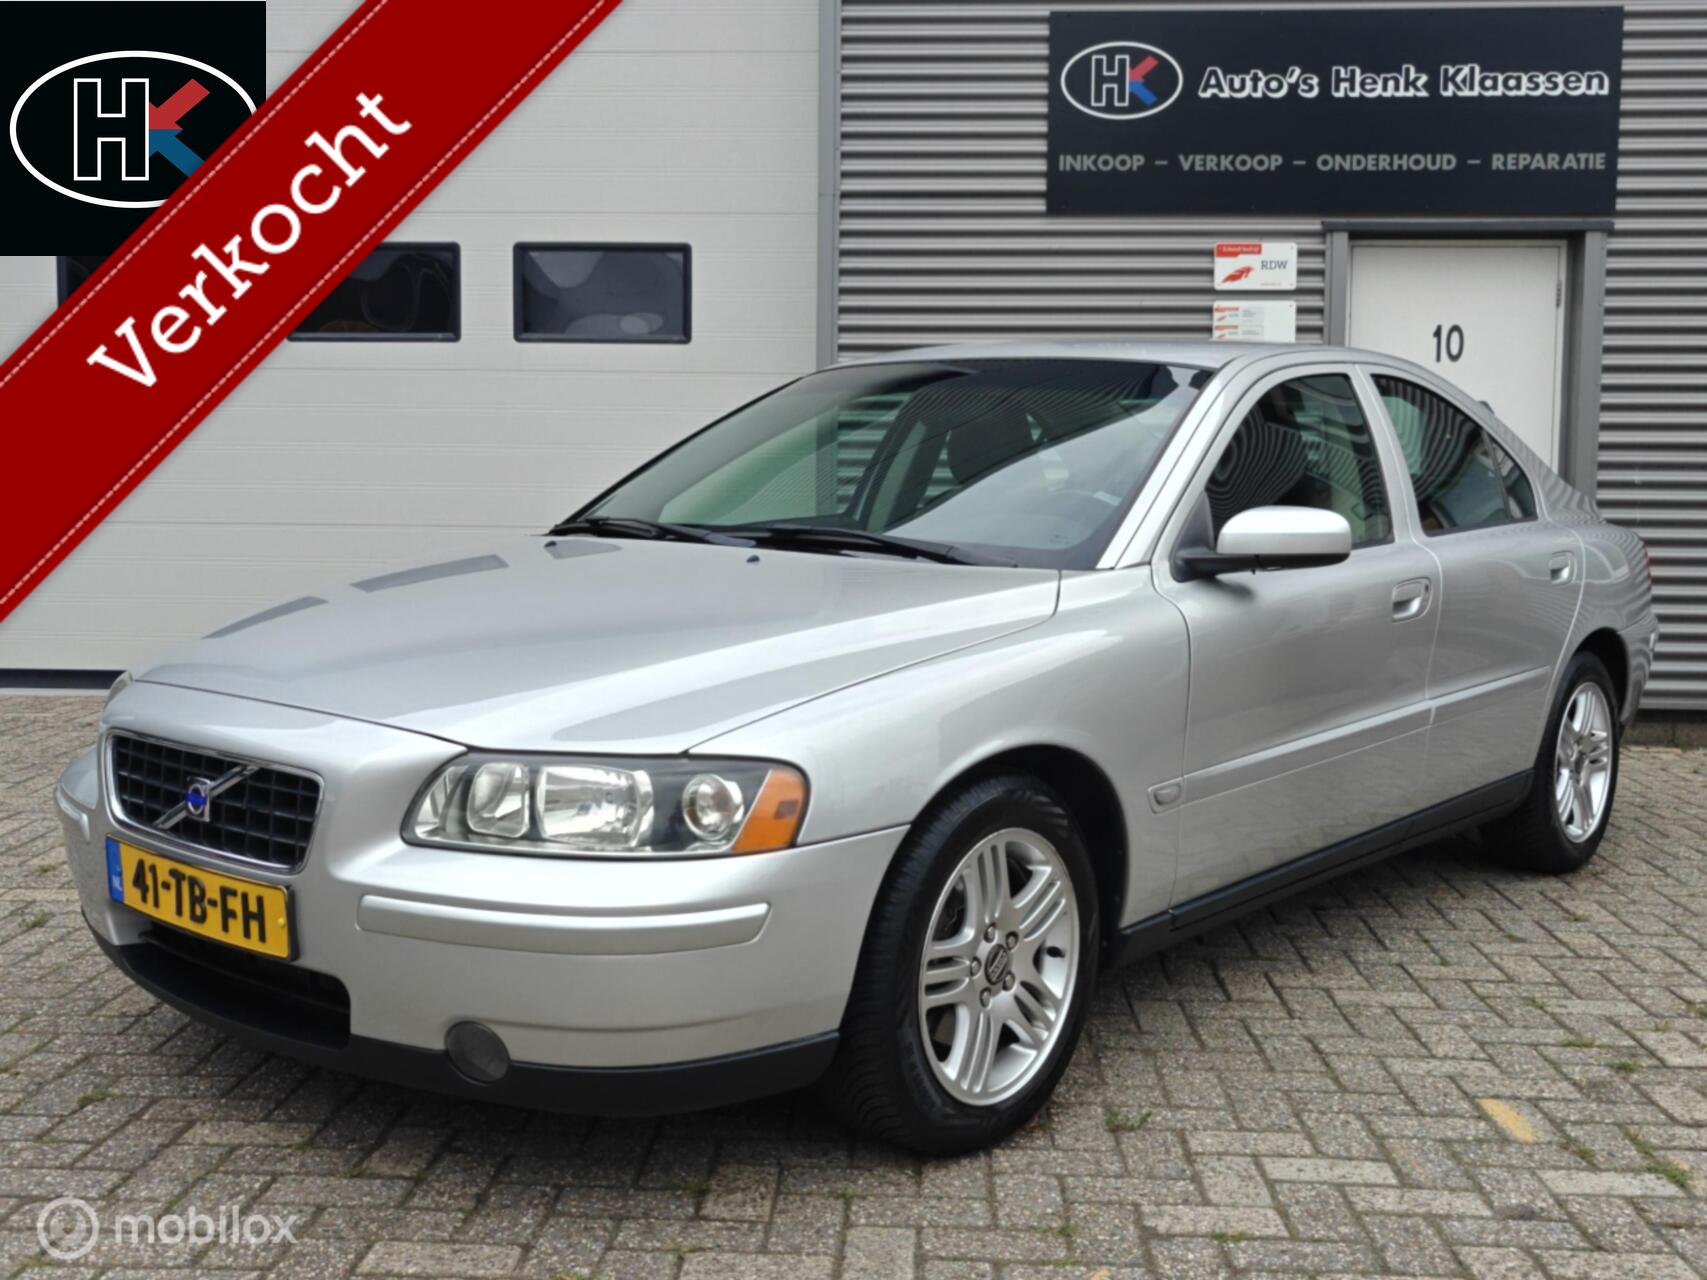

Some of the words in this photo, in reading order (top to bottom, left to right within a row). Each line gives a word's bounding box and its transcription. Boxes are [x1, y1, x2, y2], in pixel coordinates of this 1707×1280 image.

[1198, 65, 1320, 98] Auto's
[1331, 64, 1430, 98] Henk
[1439, 63, 1610, 97] Klaassen
[1058, 153, 1145, 172] INKOOP
[1178, 153, 1283, 172] VERKOOP
[1316, 152, 1457, 172] ONDERHOUD
[1491, 152, 1606, 171] REPARATIE
[1260, 259, 1288, 271] RDW
[1432, 324, 1464, 363] 10
[132, 858, 267, 944] 41-TB-FH
